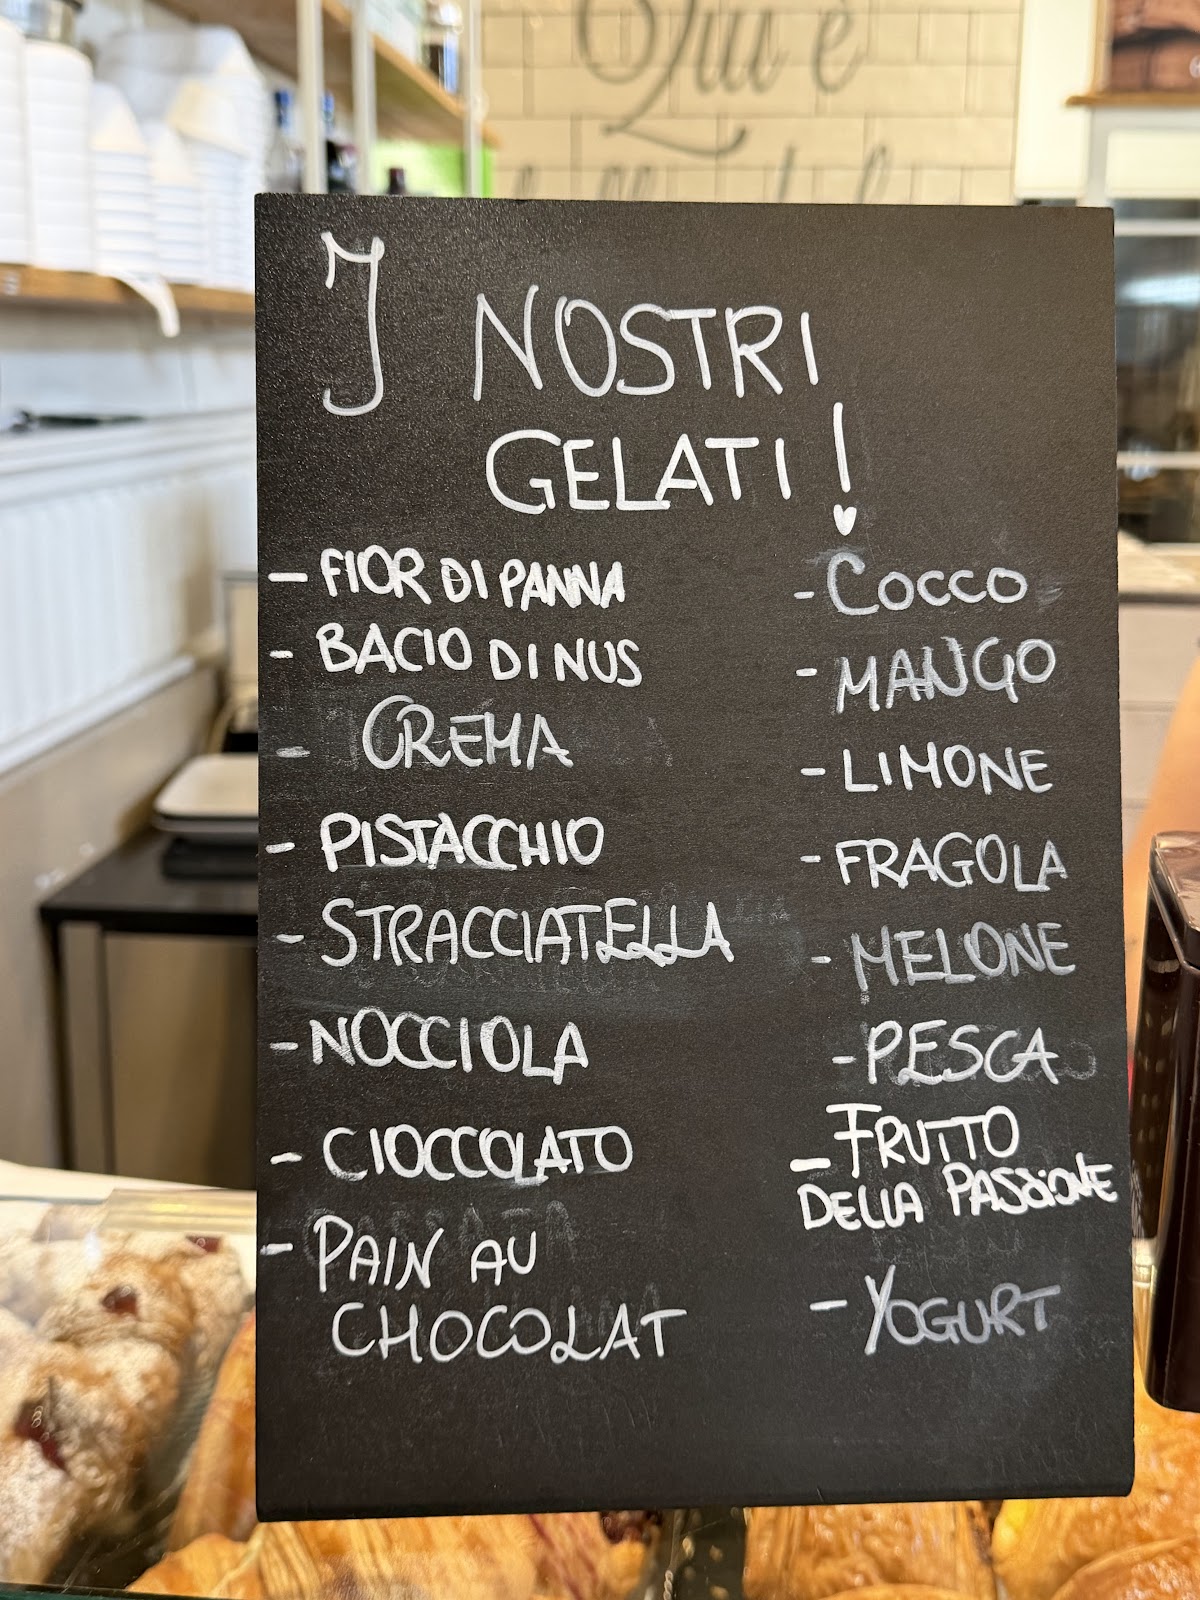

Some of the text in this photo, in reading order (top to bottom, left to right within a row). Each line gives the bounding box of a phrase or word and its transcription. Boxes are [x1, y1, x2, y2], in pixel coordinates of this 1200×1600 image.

[473, 284, 818, 401] NOSTRI
[486, 429, 791, 514] GELATI
[320, 545, 625, 611] FIOR DI PANNA
[316, 623, 642, 687] BACIO DI NUS
[836, 637, 1056, 713] MANGO
[362, 695, 573, 770] CREMA
[843, 742, 1053, 795] LIMONE
[320, 812, 604, 872] PISTACCHIO
[836, 832, 1068, 892] FRAGOLA
[321, 898, 734, 967] STRACCIATELLA
[851, 922, 1075, 983] MELONE
[310, 1007, 588, 1085] NOCCIOLA
[867, 1020, 1059, 1085] PESCA
[323, 1124, 633, 1186] CIOCCOLATO
[797, 1182, 924, 1230] DELLA
[314, 1215, 536, 1292] PAIN AU
[332, 1303, 687, 1363] CHOCOLAT
[865, 1265, 1060, 1355] YOGURT
